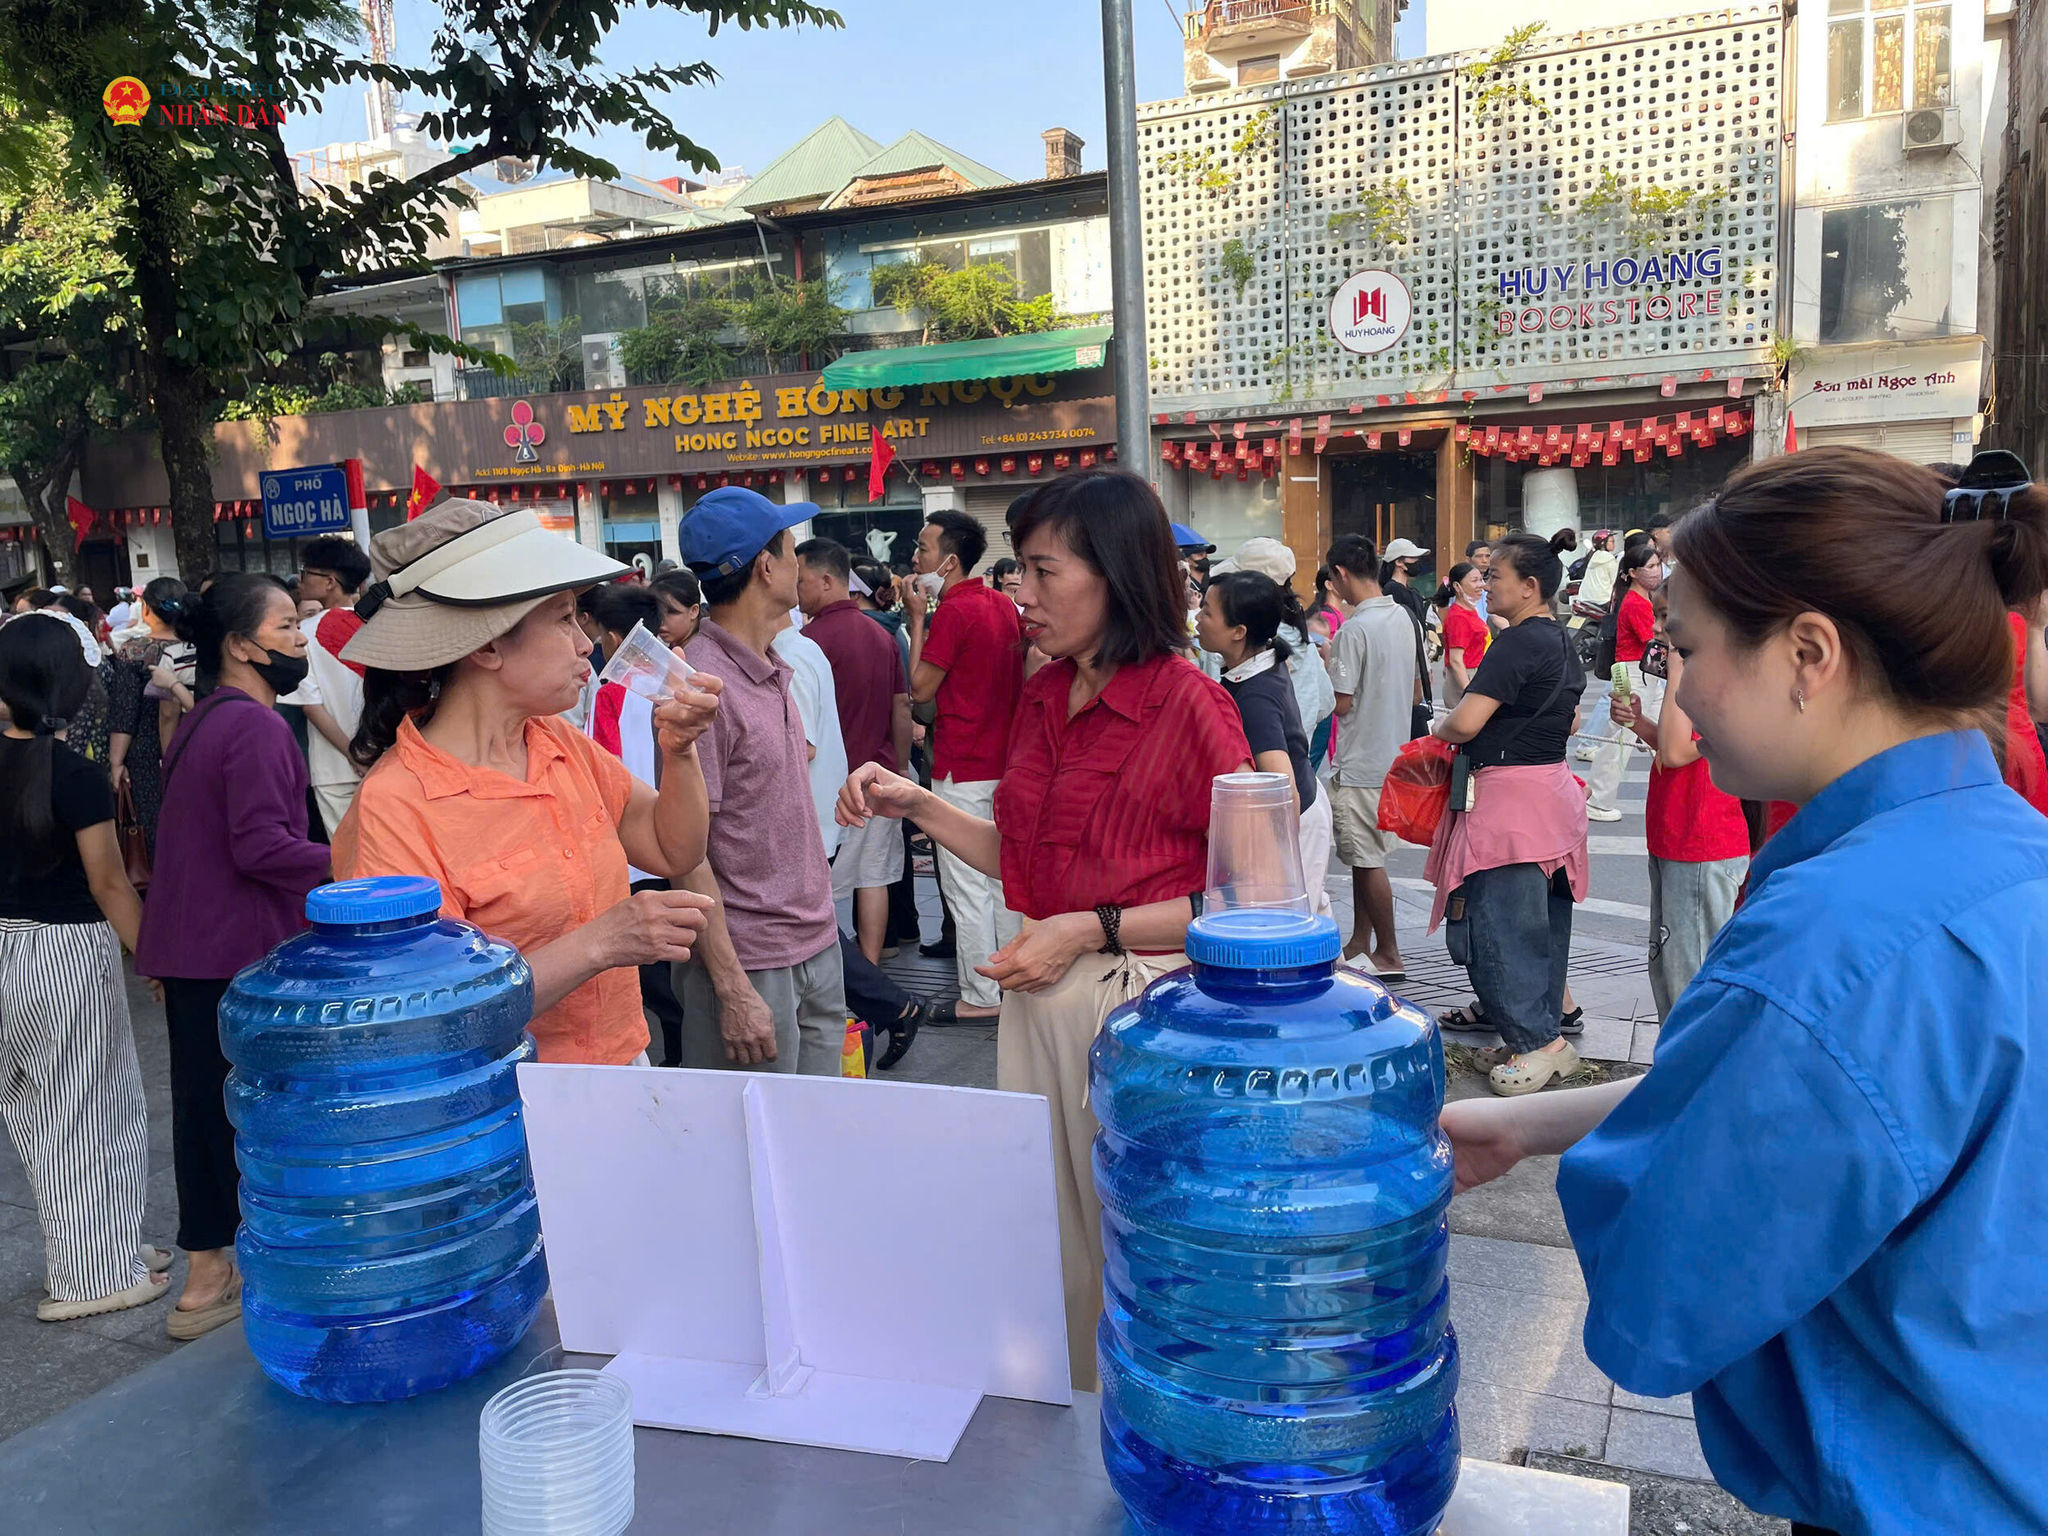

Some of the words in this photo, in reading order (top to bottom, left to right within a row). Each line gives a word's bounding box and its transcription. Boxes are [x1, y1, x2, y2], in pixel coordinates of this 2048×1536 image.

[1500, 265, 1575, 297] HUY
[1584, 247, 1722, 289] HOANG
[1499, 289, 1721, 333] BOOKSTORE
[1877, 375, 1917, 391] Ngọc
[1924, 370, 1956, 387] Anh
[568, 392, 629, 433] MỸ
[643, 379, 762, 429] NGHỆ
[675, 431, 737, 452] HONG
[746, 426, 810, 449] NGOC
[819, 422, 870, 444] FINE
[882, 417, 930, 440] ART
[295, 472, 323, 492] PHỐ
[271, 500, 317, 529] NGỌC
[320, 492, 345, 523] HÀ
